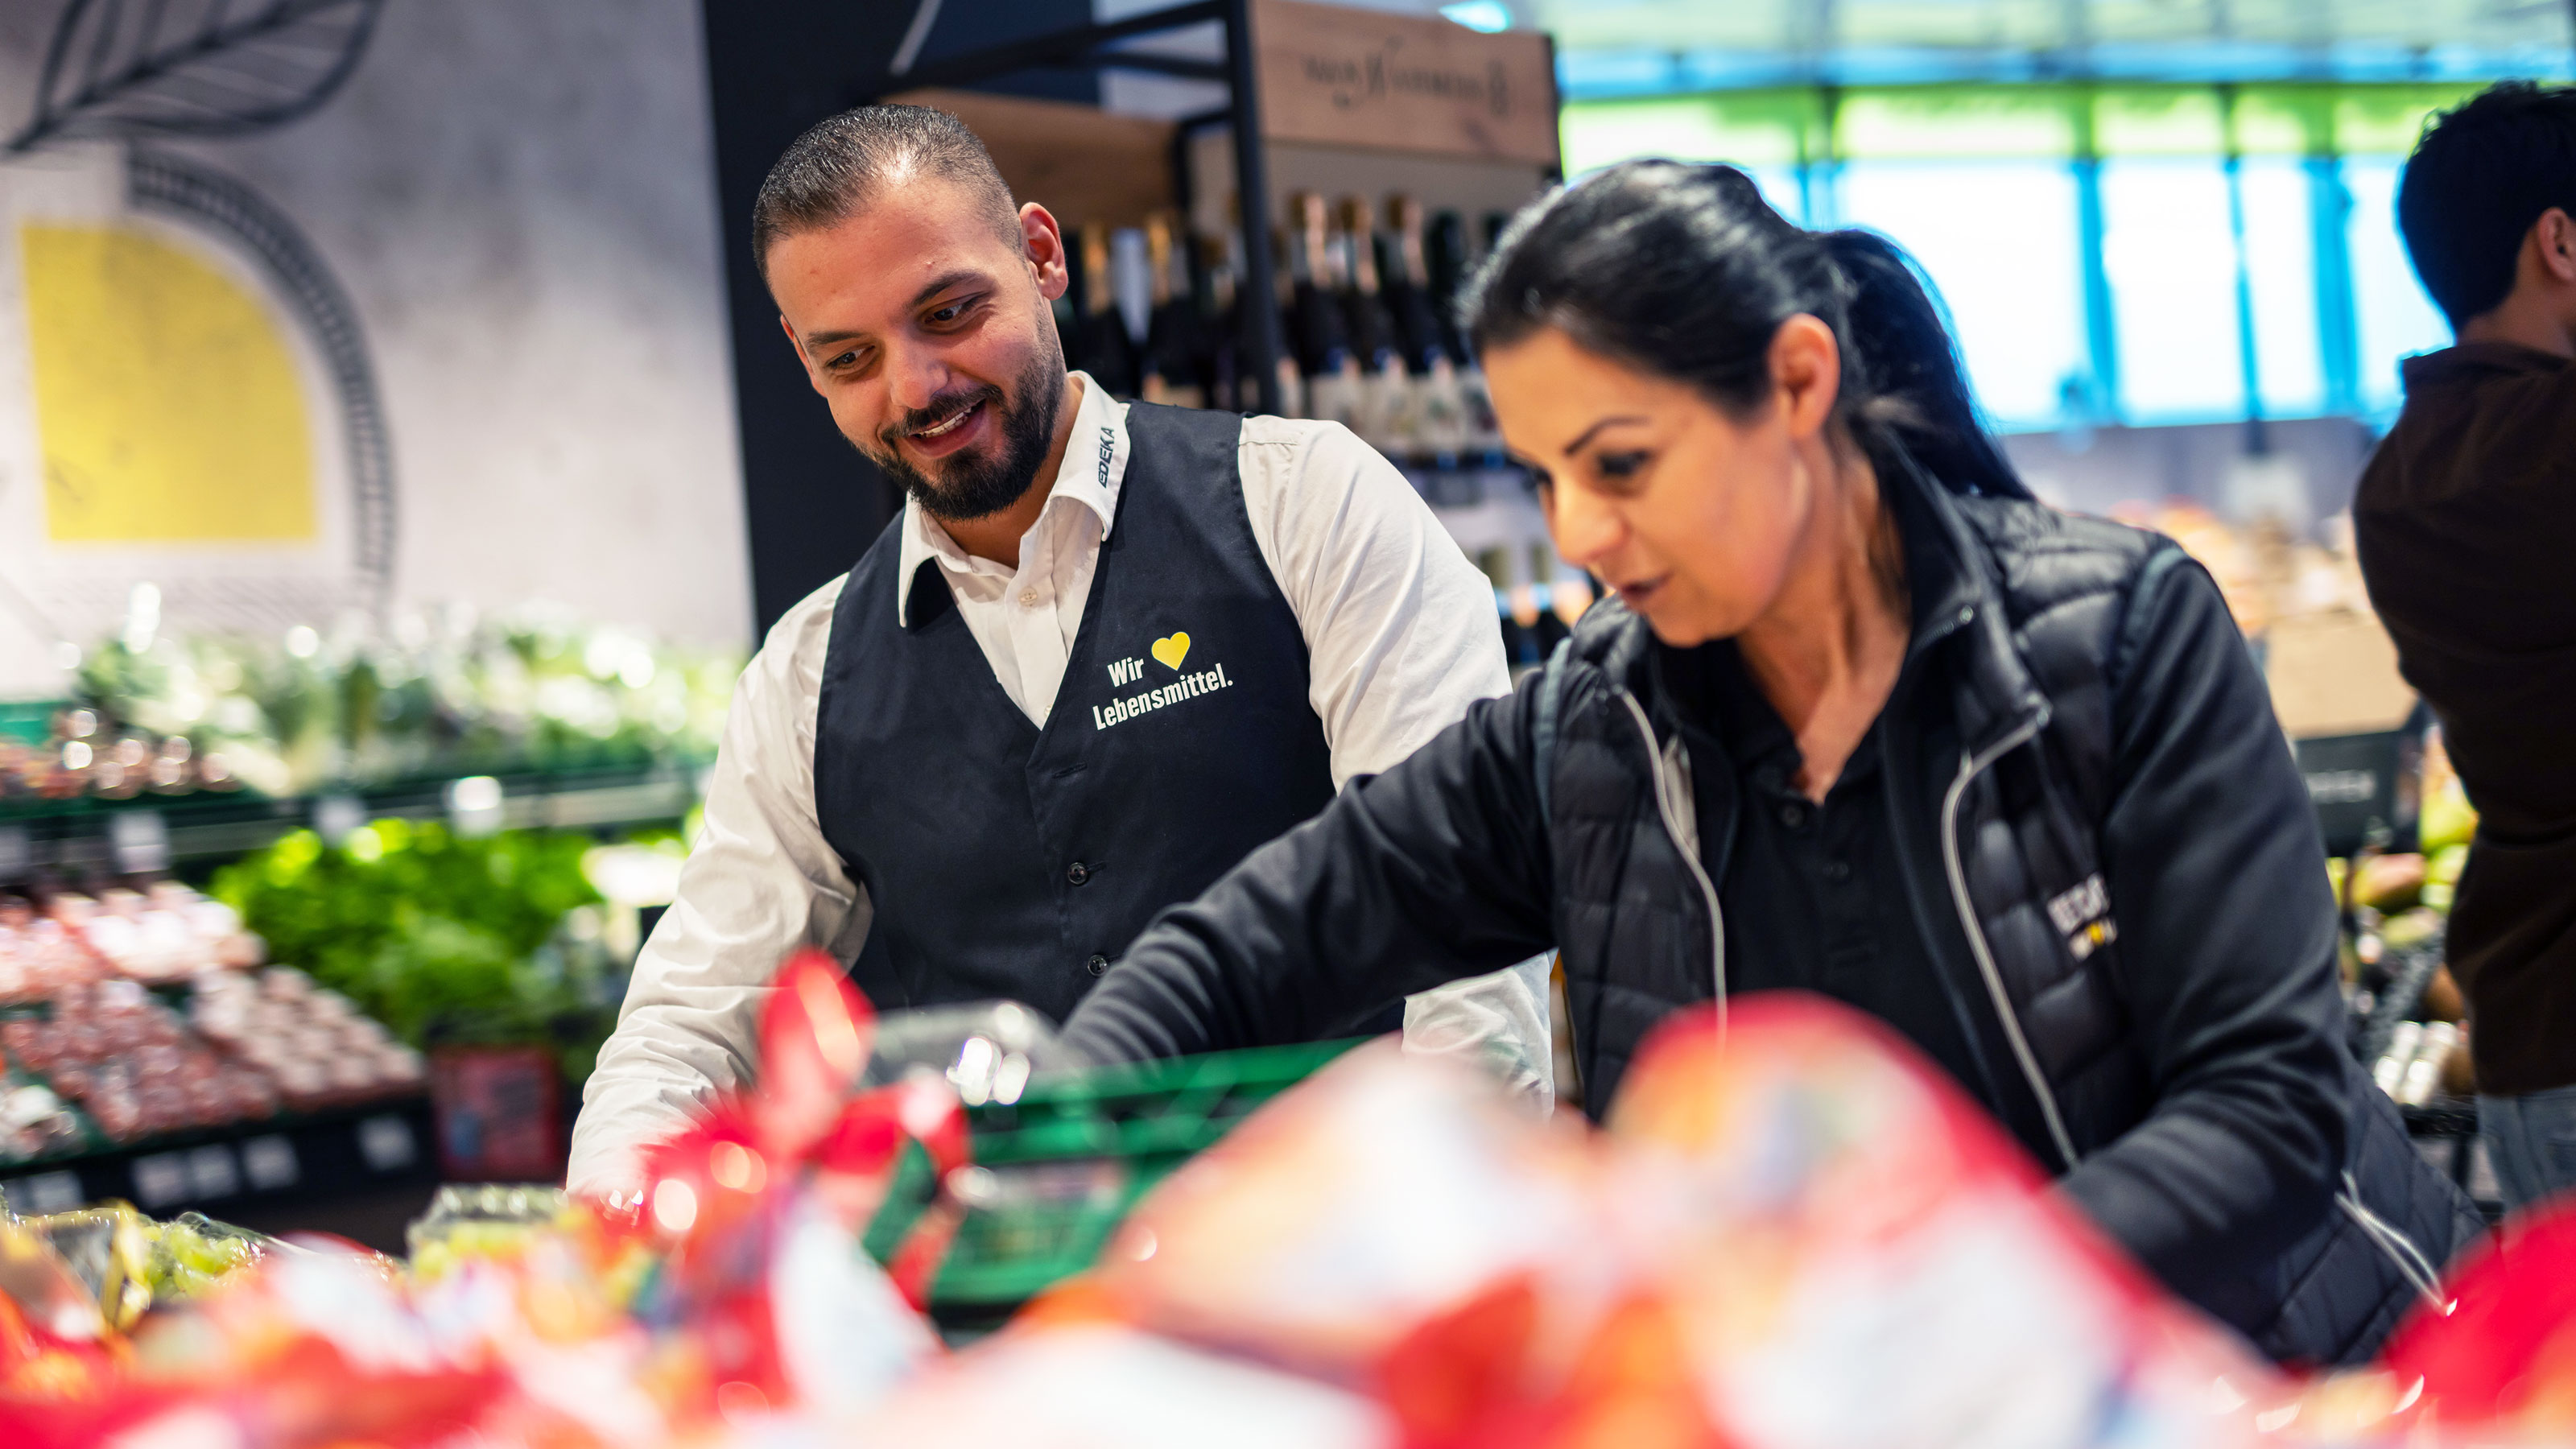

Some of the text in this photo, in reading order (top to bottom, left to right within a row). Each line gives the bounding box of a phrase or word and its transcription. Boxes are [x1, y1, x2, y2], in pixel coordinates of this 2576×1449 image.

[1098, 427, 1115, 489] EDEKA
[1092, 663, 1233, 730] Lebensmittel.
[1108, 657, 1144, 687] Wir
